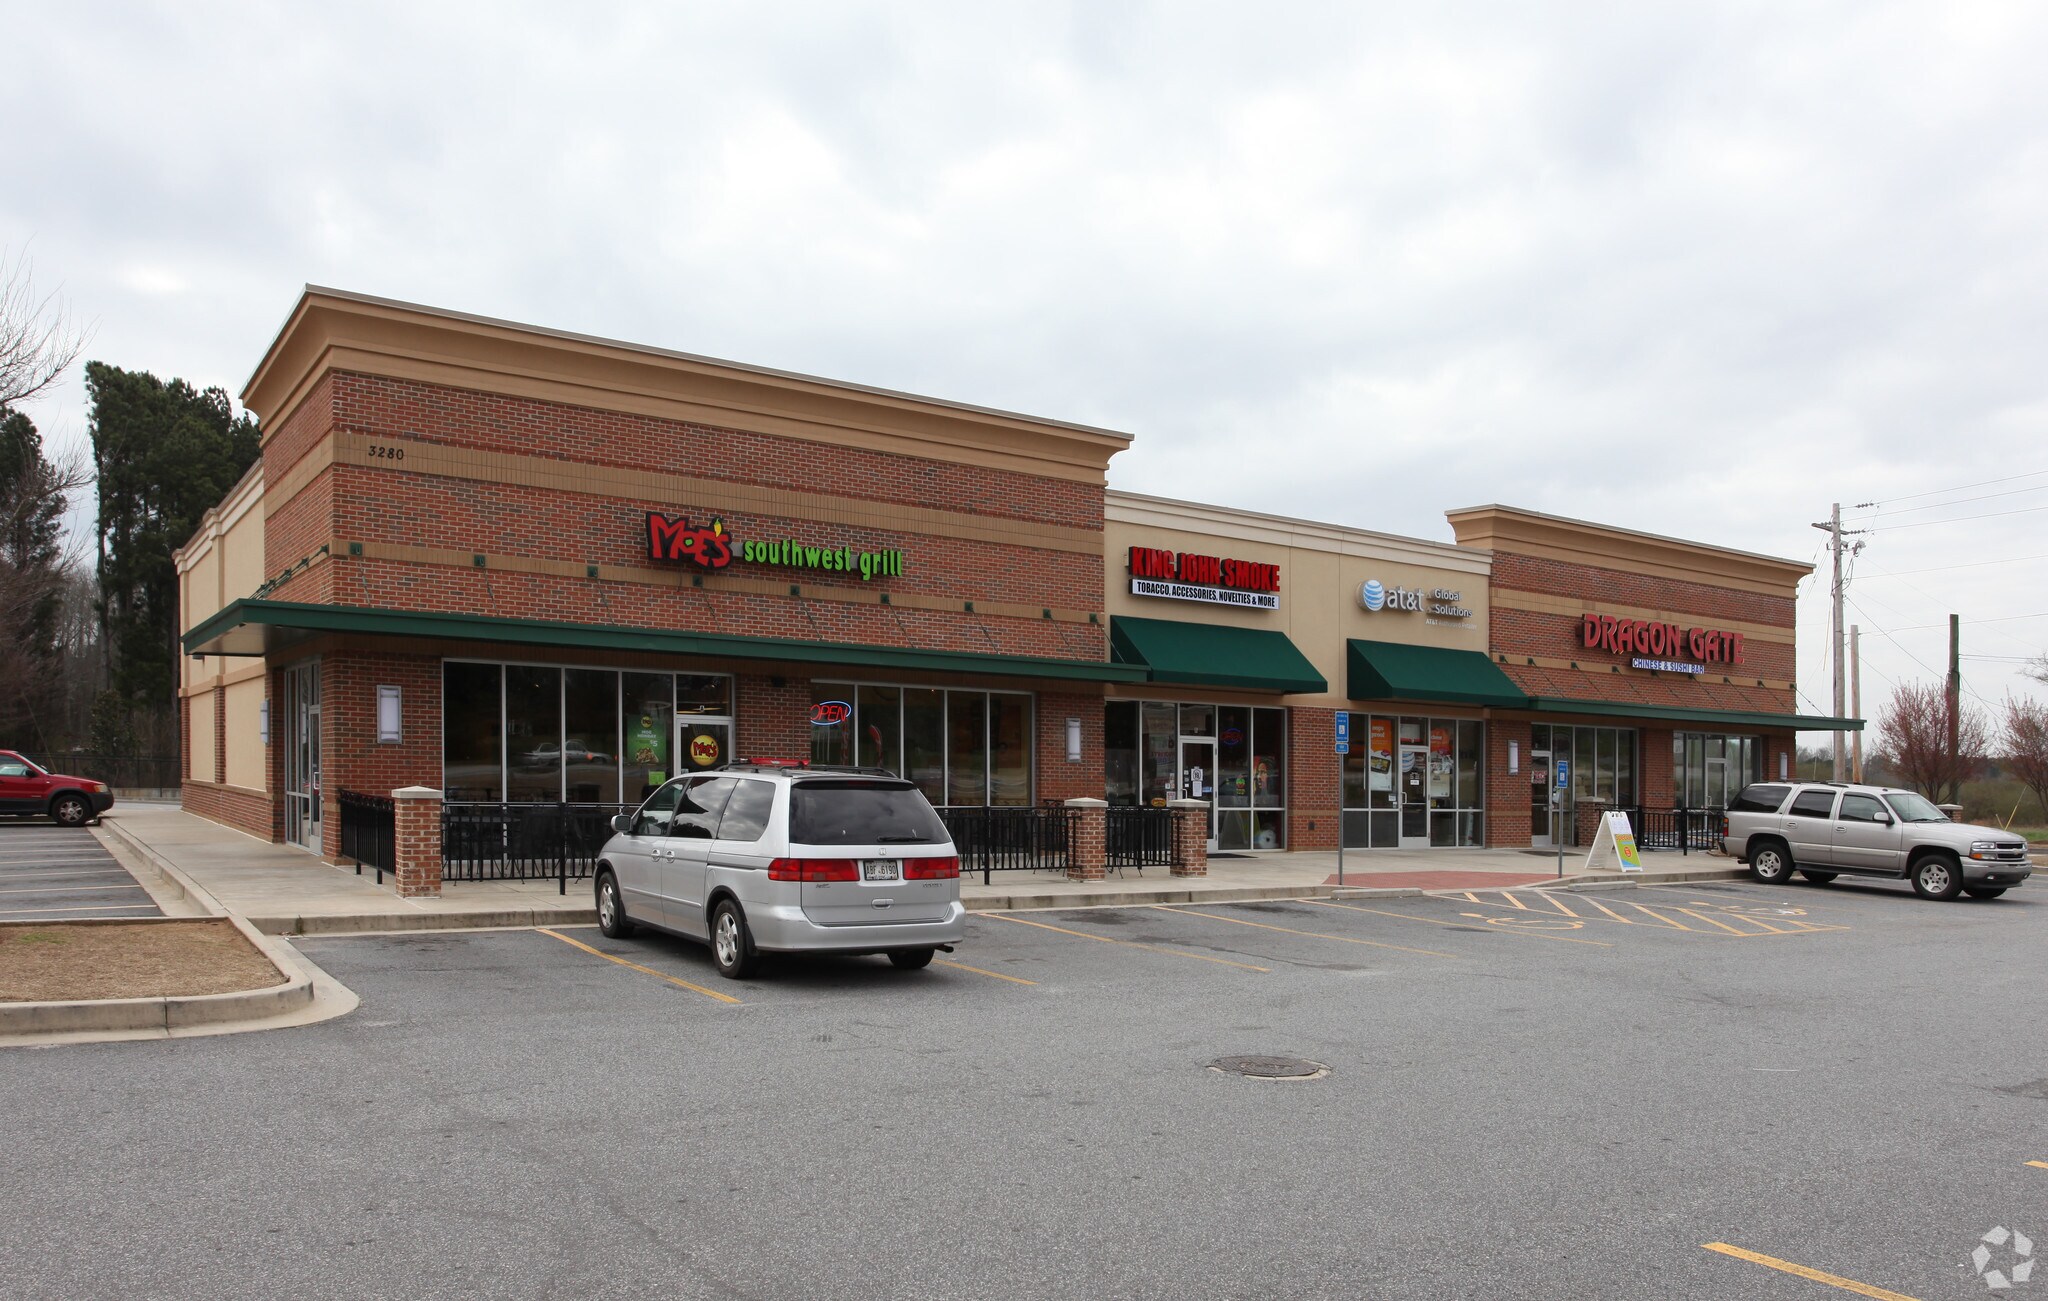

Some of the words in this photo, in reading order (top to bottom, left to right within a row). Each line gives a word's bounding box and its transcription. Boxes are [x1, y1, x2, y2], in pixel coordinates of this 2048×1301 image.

[368, 445, 404, 460] 3280
[744, 539, 851, 571] southwest
[860, 550, 902, 581] grill
[1130, 546, 1175, 579] KING
[1179, 552, 1221, 585] JOHN
[1223, 558, 1280, 592] SMOKE
[1137, 581, 1171, 596] TOBACCO,
[1172, 585, 1218, 602] ACCESSORIES,
[1219, 590, 1251, 605] NOVELTIES
[1251, 596, 1257, 605] &
[1258, 595, 1275, 608] MORE
[1387, 586, 1424, 612] at&t
[1434, 588, 1461, 602] Global
[1435, 604, 1473, 618] Solutions
[1583, 613, 1681, 656] DRAGON
[1689, 627, 1745, 664] GATE
[1633, 658, 1662, 670] CHINESE
[1664, 662, 1669, 671] &
[1670, 662, 1690, 673] SUSHI
[1691, 664, 1705, 674] BAR
[810, 704, 849, 722] OPEN
